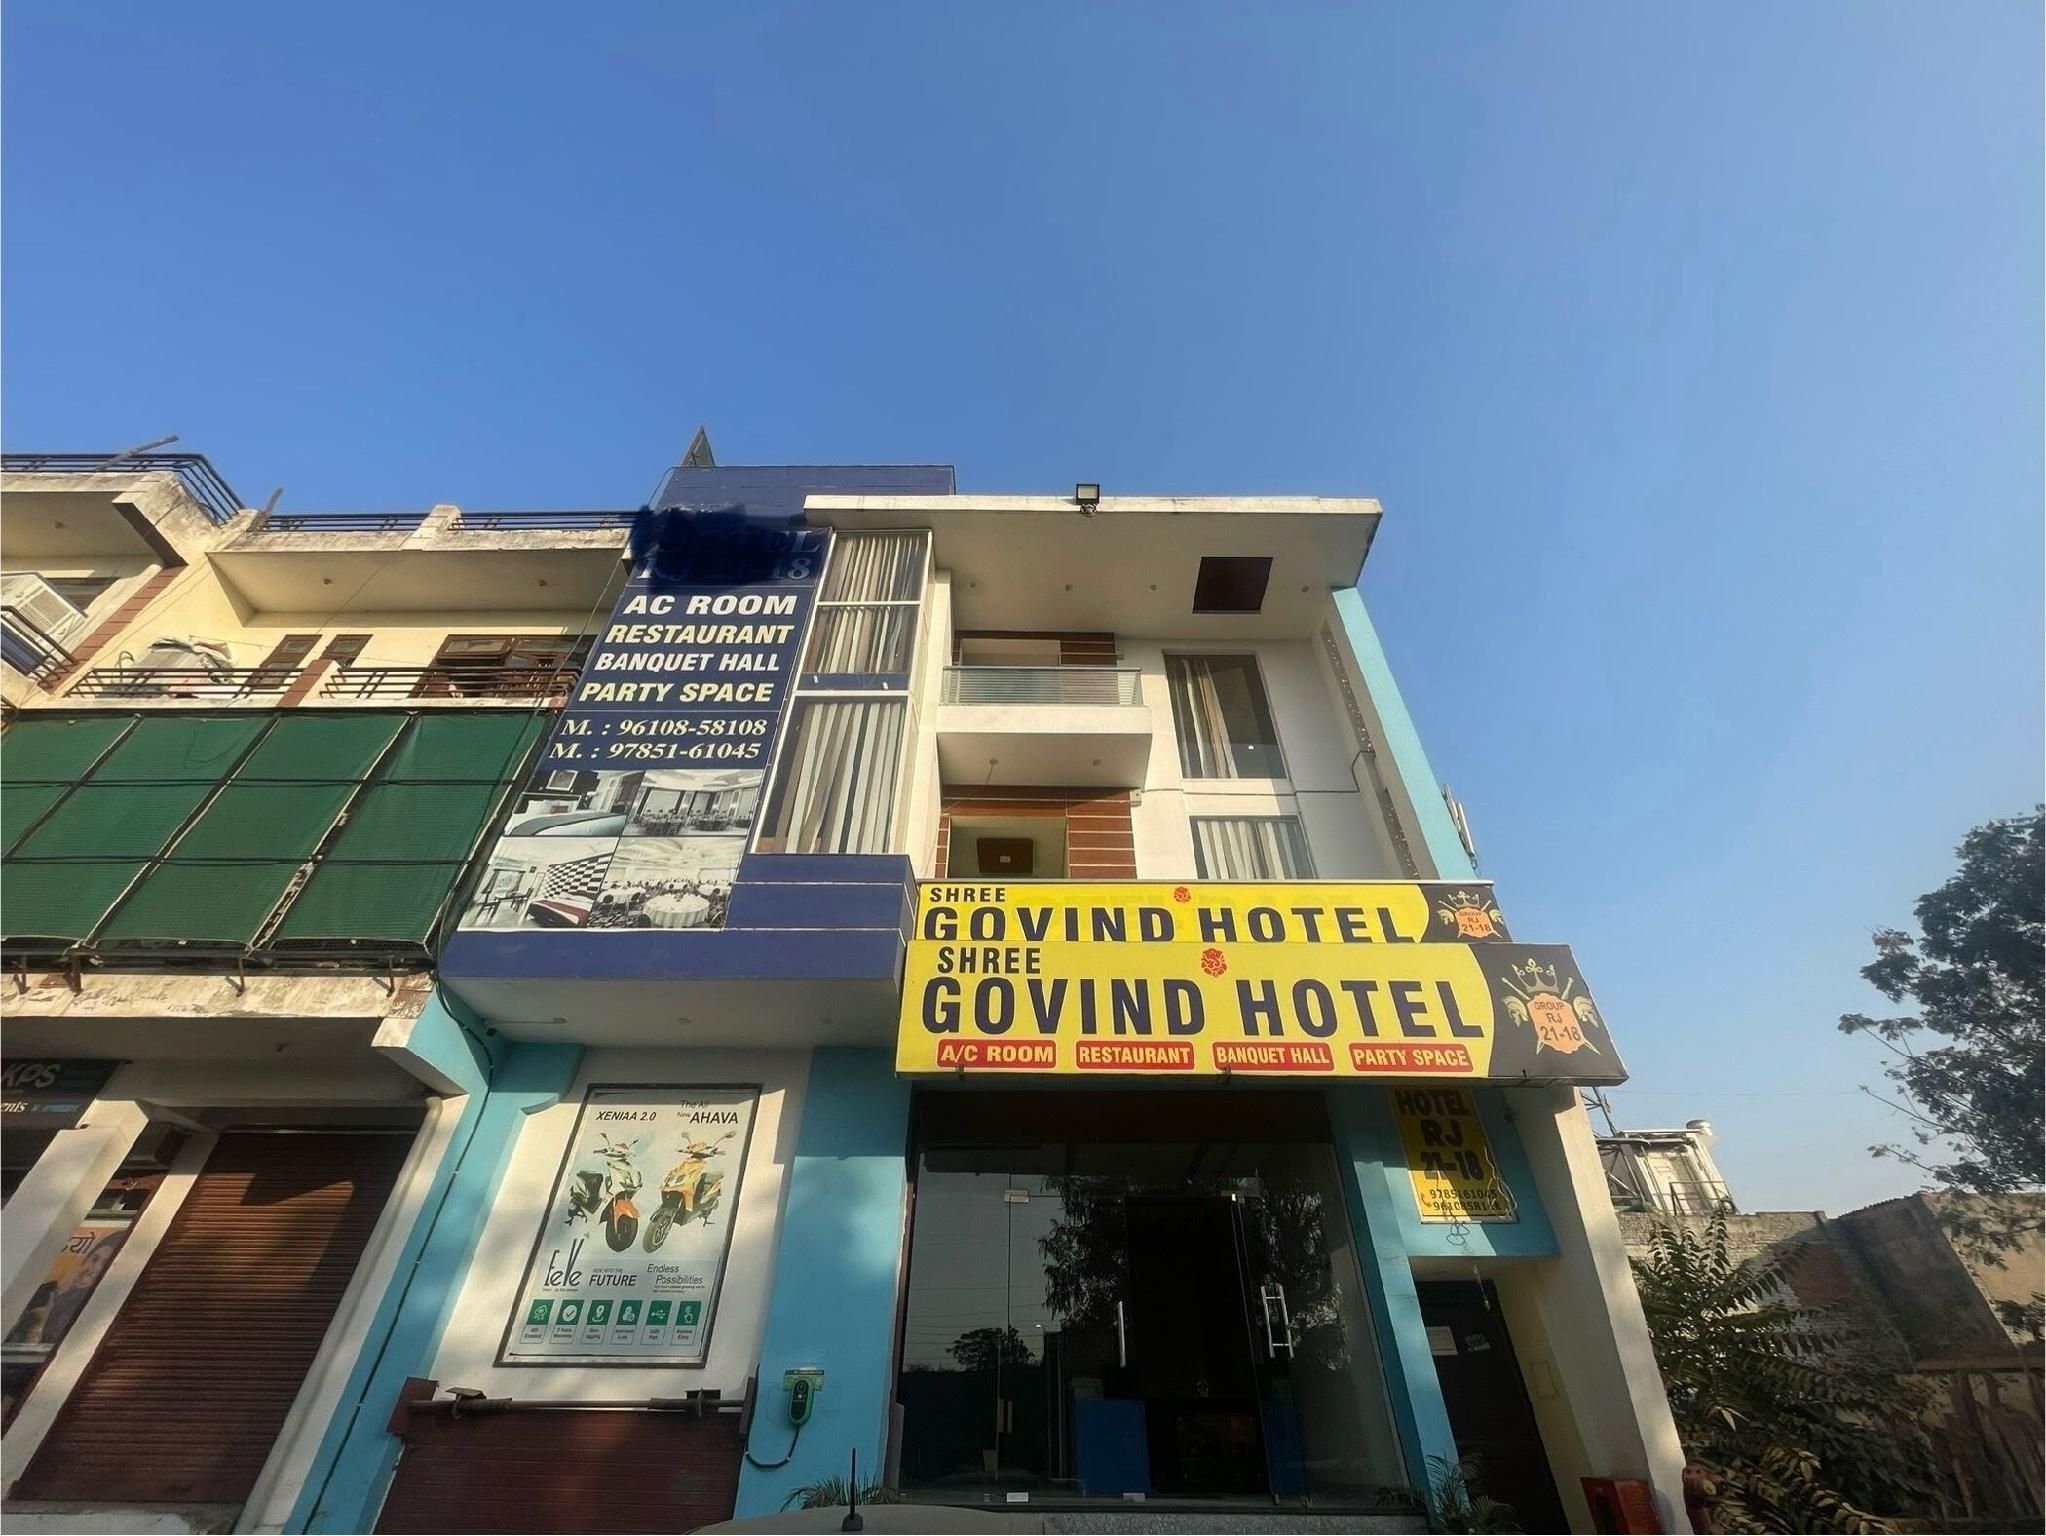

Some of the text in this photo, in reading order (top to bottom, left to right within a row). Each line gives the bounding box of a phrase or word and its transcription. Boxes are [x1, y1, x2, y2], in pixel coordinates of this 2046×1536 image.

[623, 595, 798, 615] AC ROOM
[605, 624, 795, 644] RESTAURANT
[594, 653, 780, 672] BANQUET HALL
[578, 682, 775, 702] PARTY SPACE
[559, 719, 592, 736] M.
[616, 719, 768, 736] 96108-58108
[549, 743, 582, 759] M.
[606, 743, 762, 759] 97851-61045
[930, 887, 1006, 903] SHREE
[924, 906, 1415, 943] GOVIND HOTEL
[1462, 924, 1492, 932] 21-18
[937, 946, 1041, 974] SHREE
[922, 977, 1485, 1037] GOVIND HOTEL
[1533, 1001, 1565, 1010] GROUP
[1546, 1012, 1563, 1023] RJ
[1540, 1025, 1582, 1041] 21-18
[940, 1045, 1053, 1063] A/C ROOM
[1079, 1046, 1190, 1064] RESTAURANT
[1217, 1048, 1330, 1064] BANQUET HALL
[1355, 1050, 1469, 1067] PARTY SPACE
[1395, 1089, 1471, 1115] HOTEL
[596, 1111, 657, 1121] XENIAA 2.0
[689, 1112, 738, 1123] AHAVA
[1420, 1119, 1463, 1147] RJ
[647, 1264, 680, 1273] Endless
[589, 1275, 637, 1286] FUTURE
[656, 1275, 704, 1285] Possibilities
